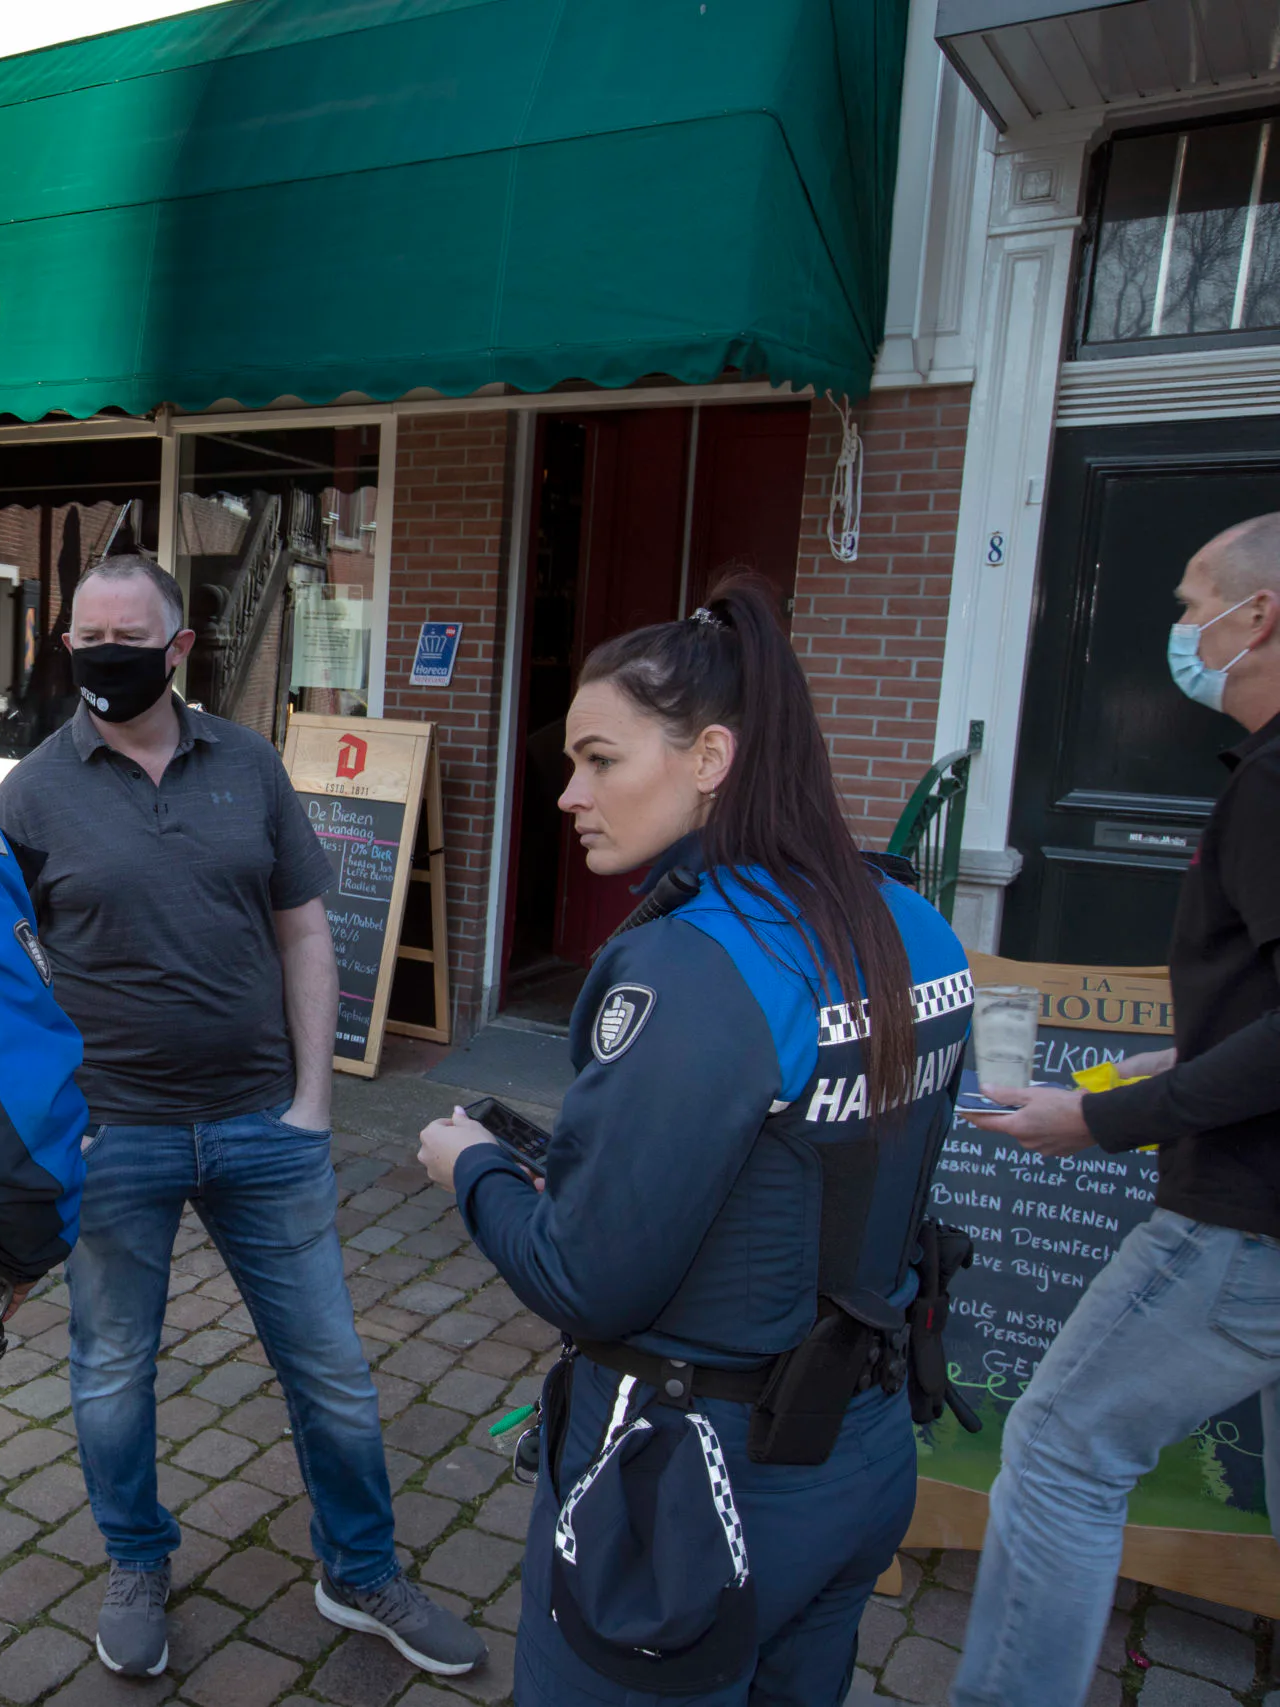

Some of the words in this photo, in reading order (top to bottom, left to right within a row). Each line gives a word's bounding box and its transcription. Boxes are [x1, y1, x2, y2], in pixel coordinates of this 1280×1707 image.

[988, 535, 1003, 562] 8
[308, 801, 326, 821] De
[312, 824, 325, 832] an
[1081, 976, 1113, 993] LA
[1038, 991, 1174, 1028] HOUFF
[1033, 1040, 1125, 1074] ELKOM
[942, 1138, 983, 1157] LEEN
[994, 1147, 1045, 1166] NAAR
[1139, 1167, 1159, 1183] VO
[1012, 1198, 1119, 1232] AFREKENEN
[972, 1252, 1002, 1272] EVE
[975, 1320, 1052, 1350] PERSON
